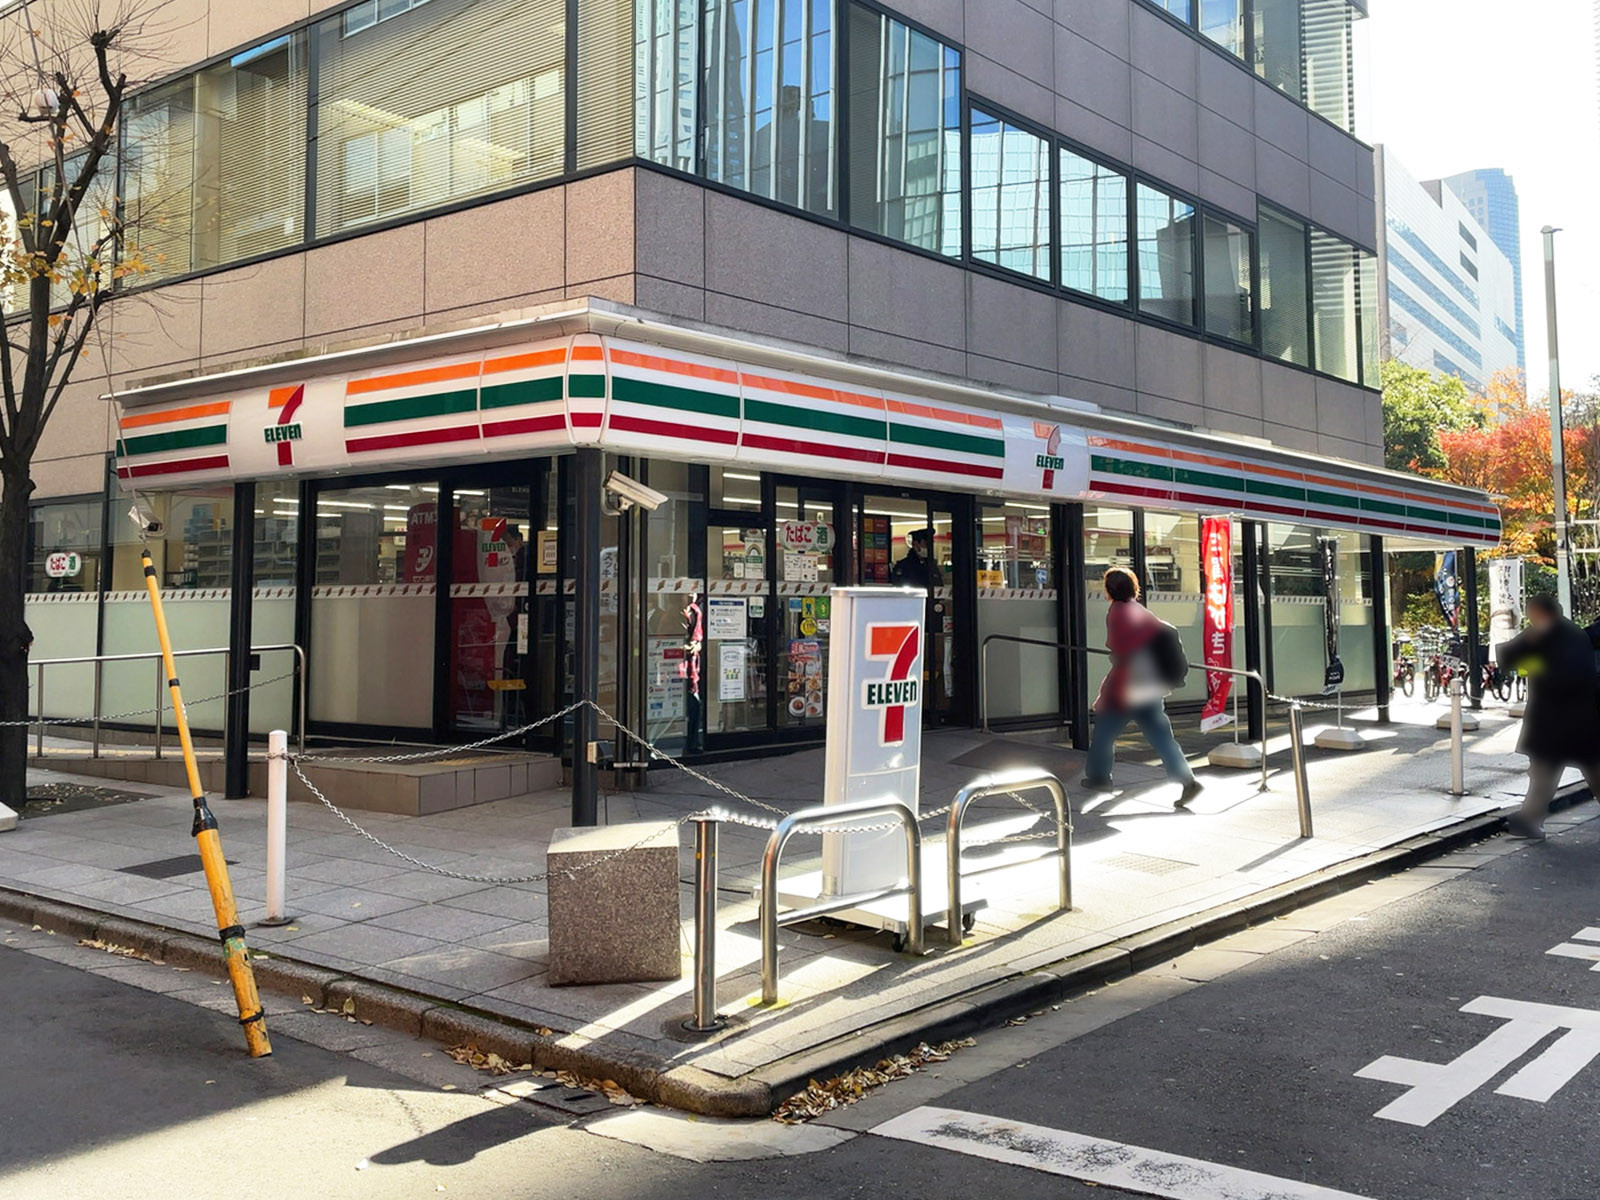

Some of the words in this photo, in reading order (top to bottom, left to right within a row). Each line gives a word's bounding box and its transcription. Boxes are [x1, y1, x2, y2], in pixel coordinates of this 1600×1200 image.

[267, 383, 305, 466] 7
[1032, 421, 1062, 490] 7
[50, 557, 66, 570] たばこ
[785, 524, 812, 543] たばこ
[816, 526, 828, 544] 酒
[870, 626, 919, 743] 7
